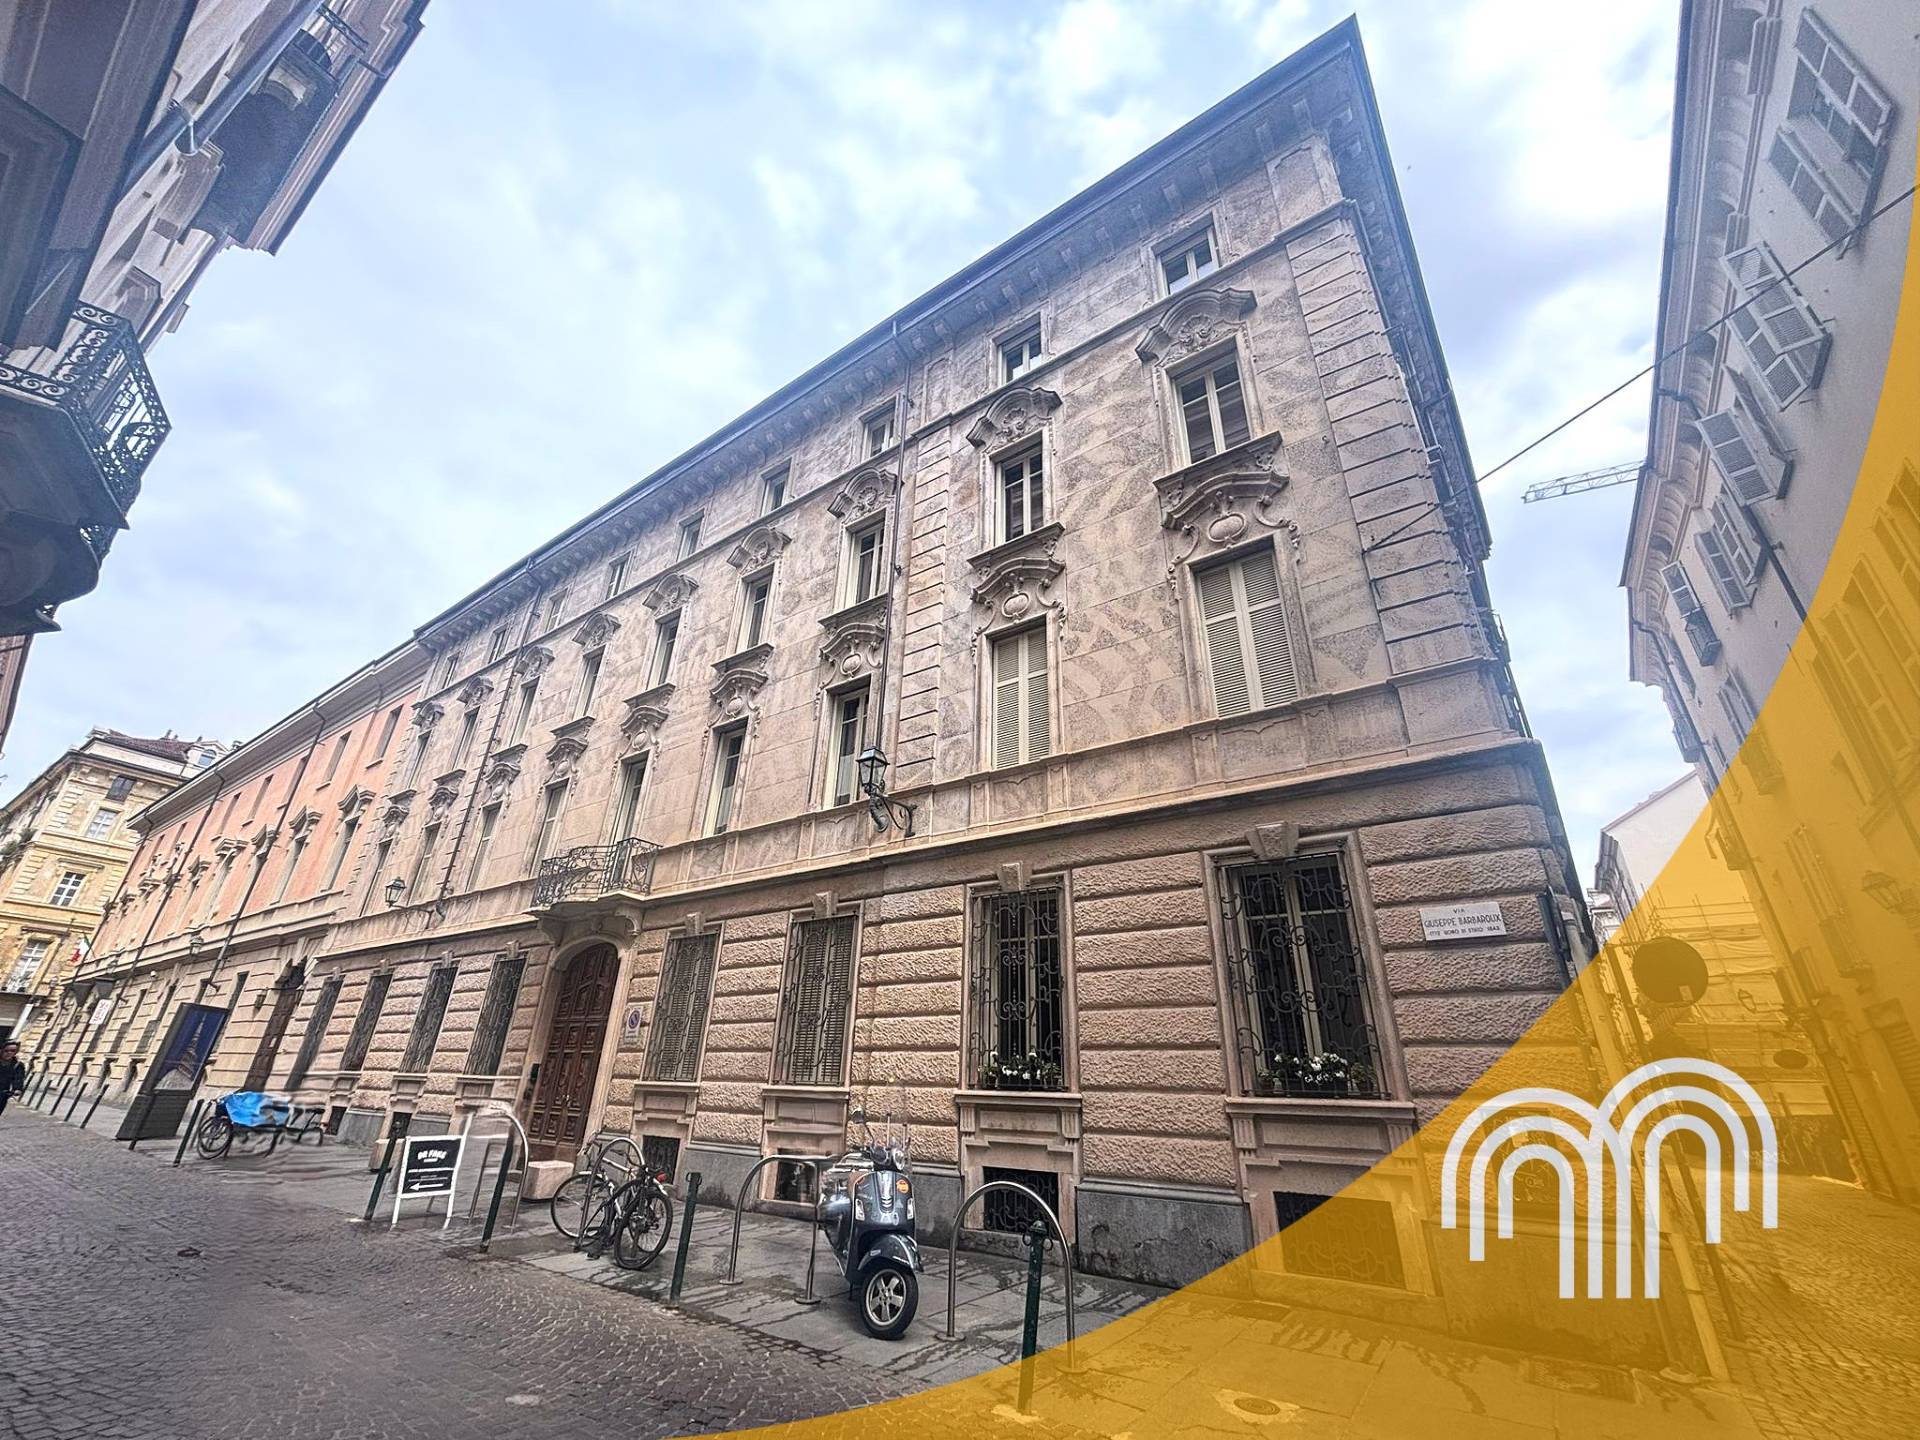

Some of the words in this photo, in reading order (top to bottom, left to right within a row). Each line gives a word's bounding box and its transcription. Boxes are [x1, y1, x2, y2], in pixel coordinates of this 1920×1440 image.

[1424, 918, 1457, 928] GIUSEPPE
[1458, 914, 1501, 925] BARBAROUX
[429, 1149, 447, 1159] FAKE
